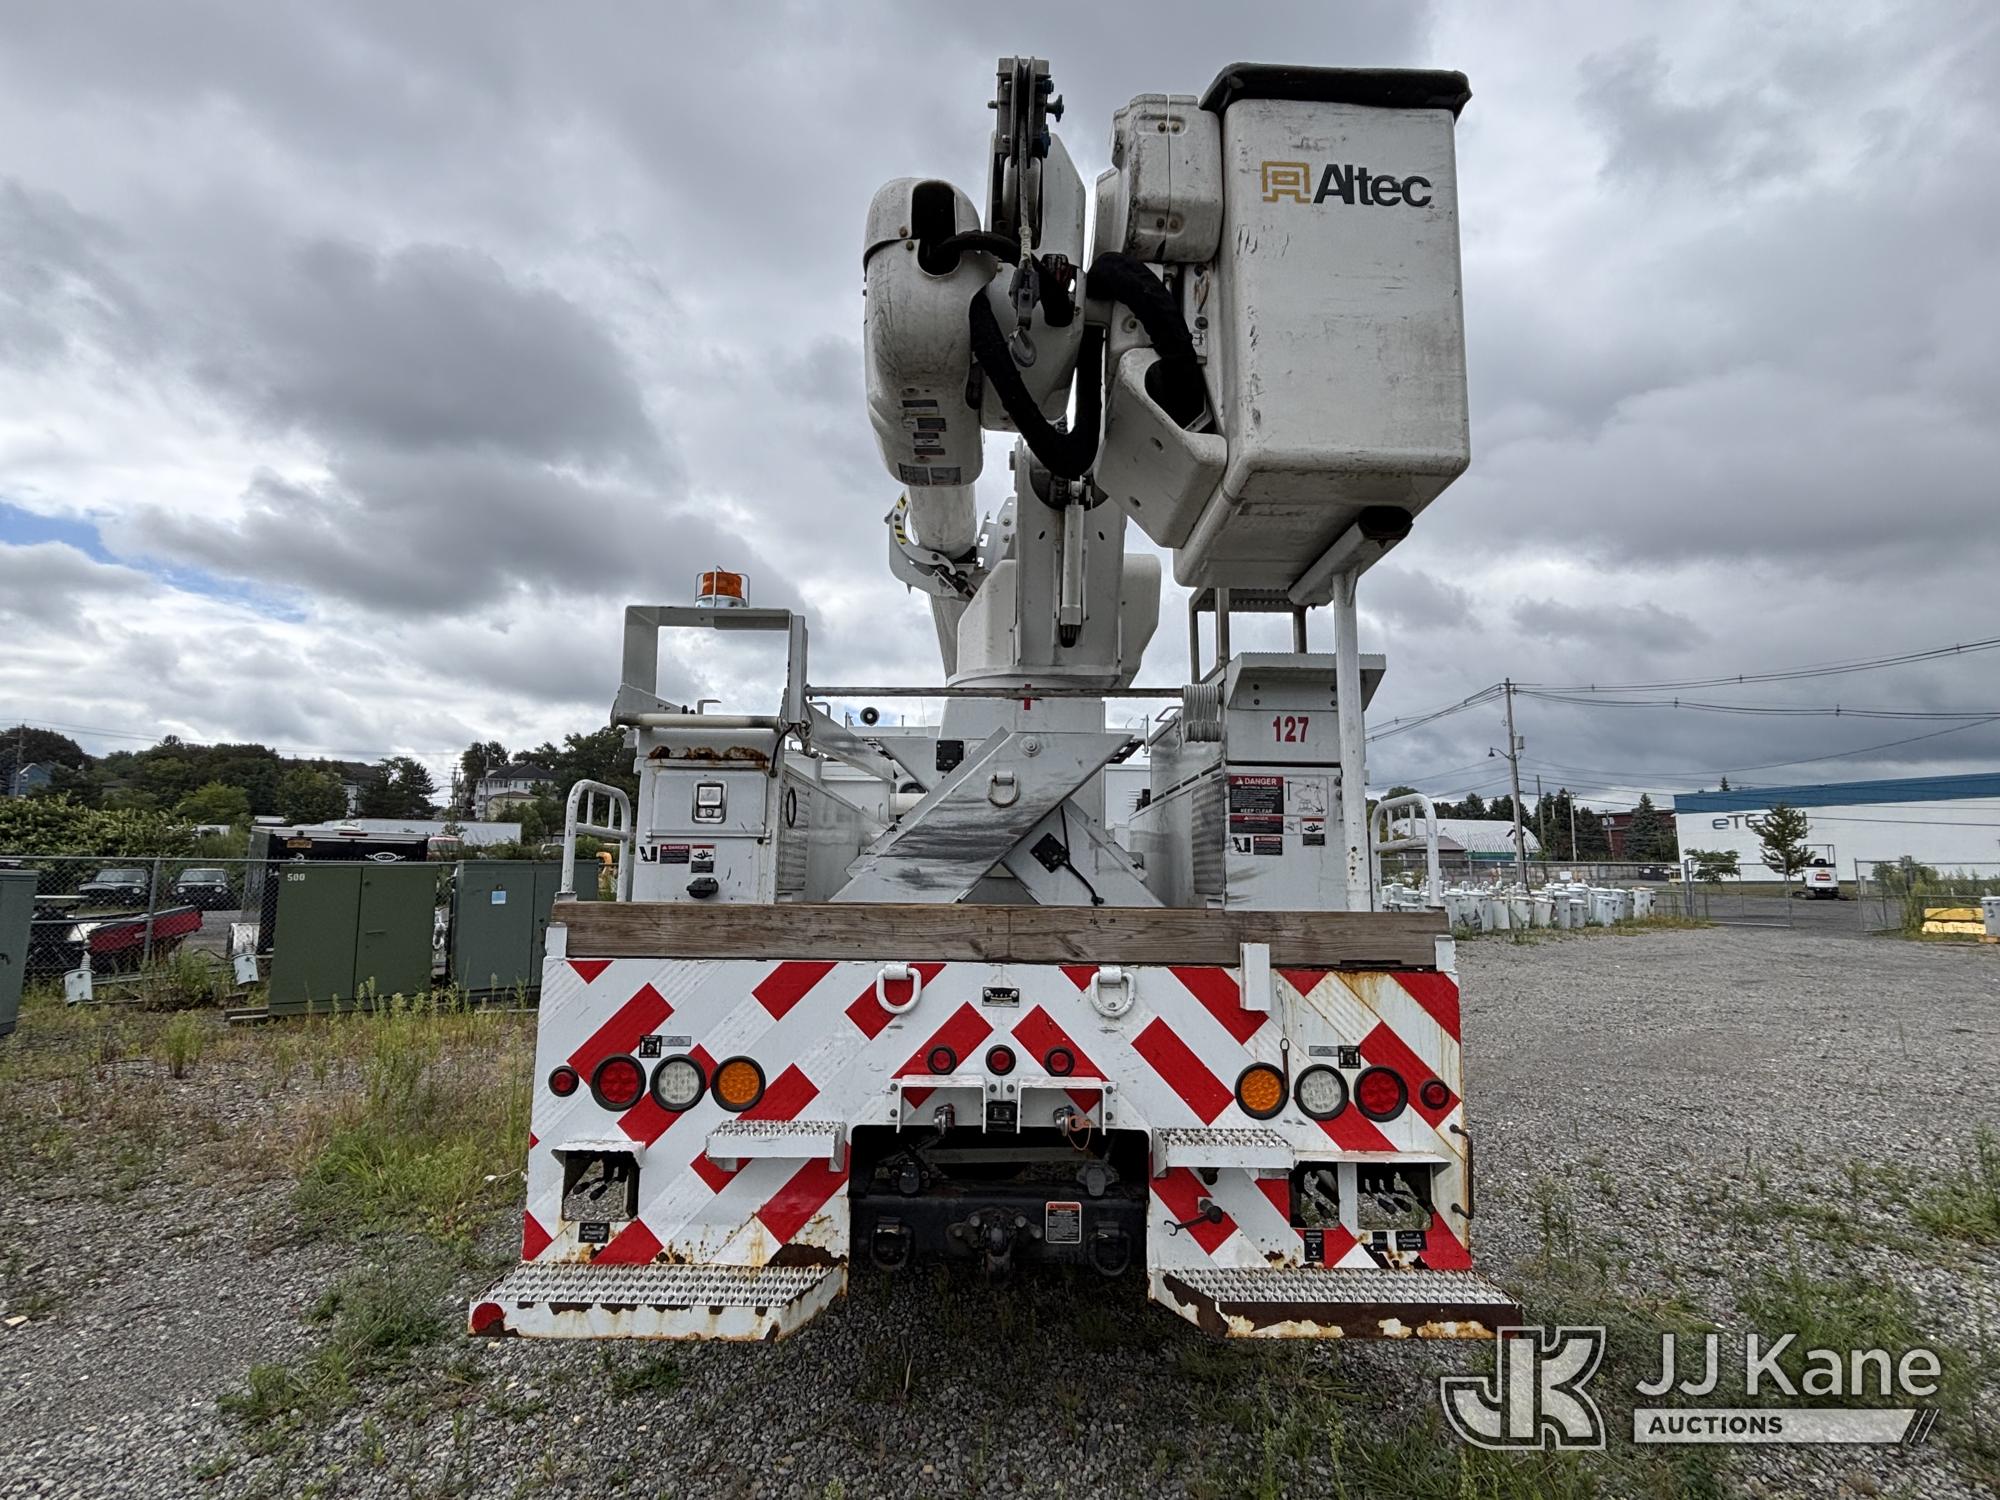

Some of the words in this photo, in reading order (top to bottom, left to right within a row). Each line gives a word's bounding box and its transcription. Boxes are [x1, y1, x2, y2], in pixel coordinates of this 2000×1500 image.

[1313, 164, 1432, 207] Altec
[1273, 716, 1309, 742] 127
[1244, 777, 1277, 785] DANGER
[287, 873, 306, 881] 500
